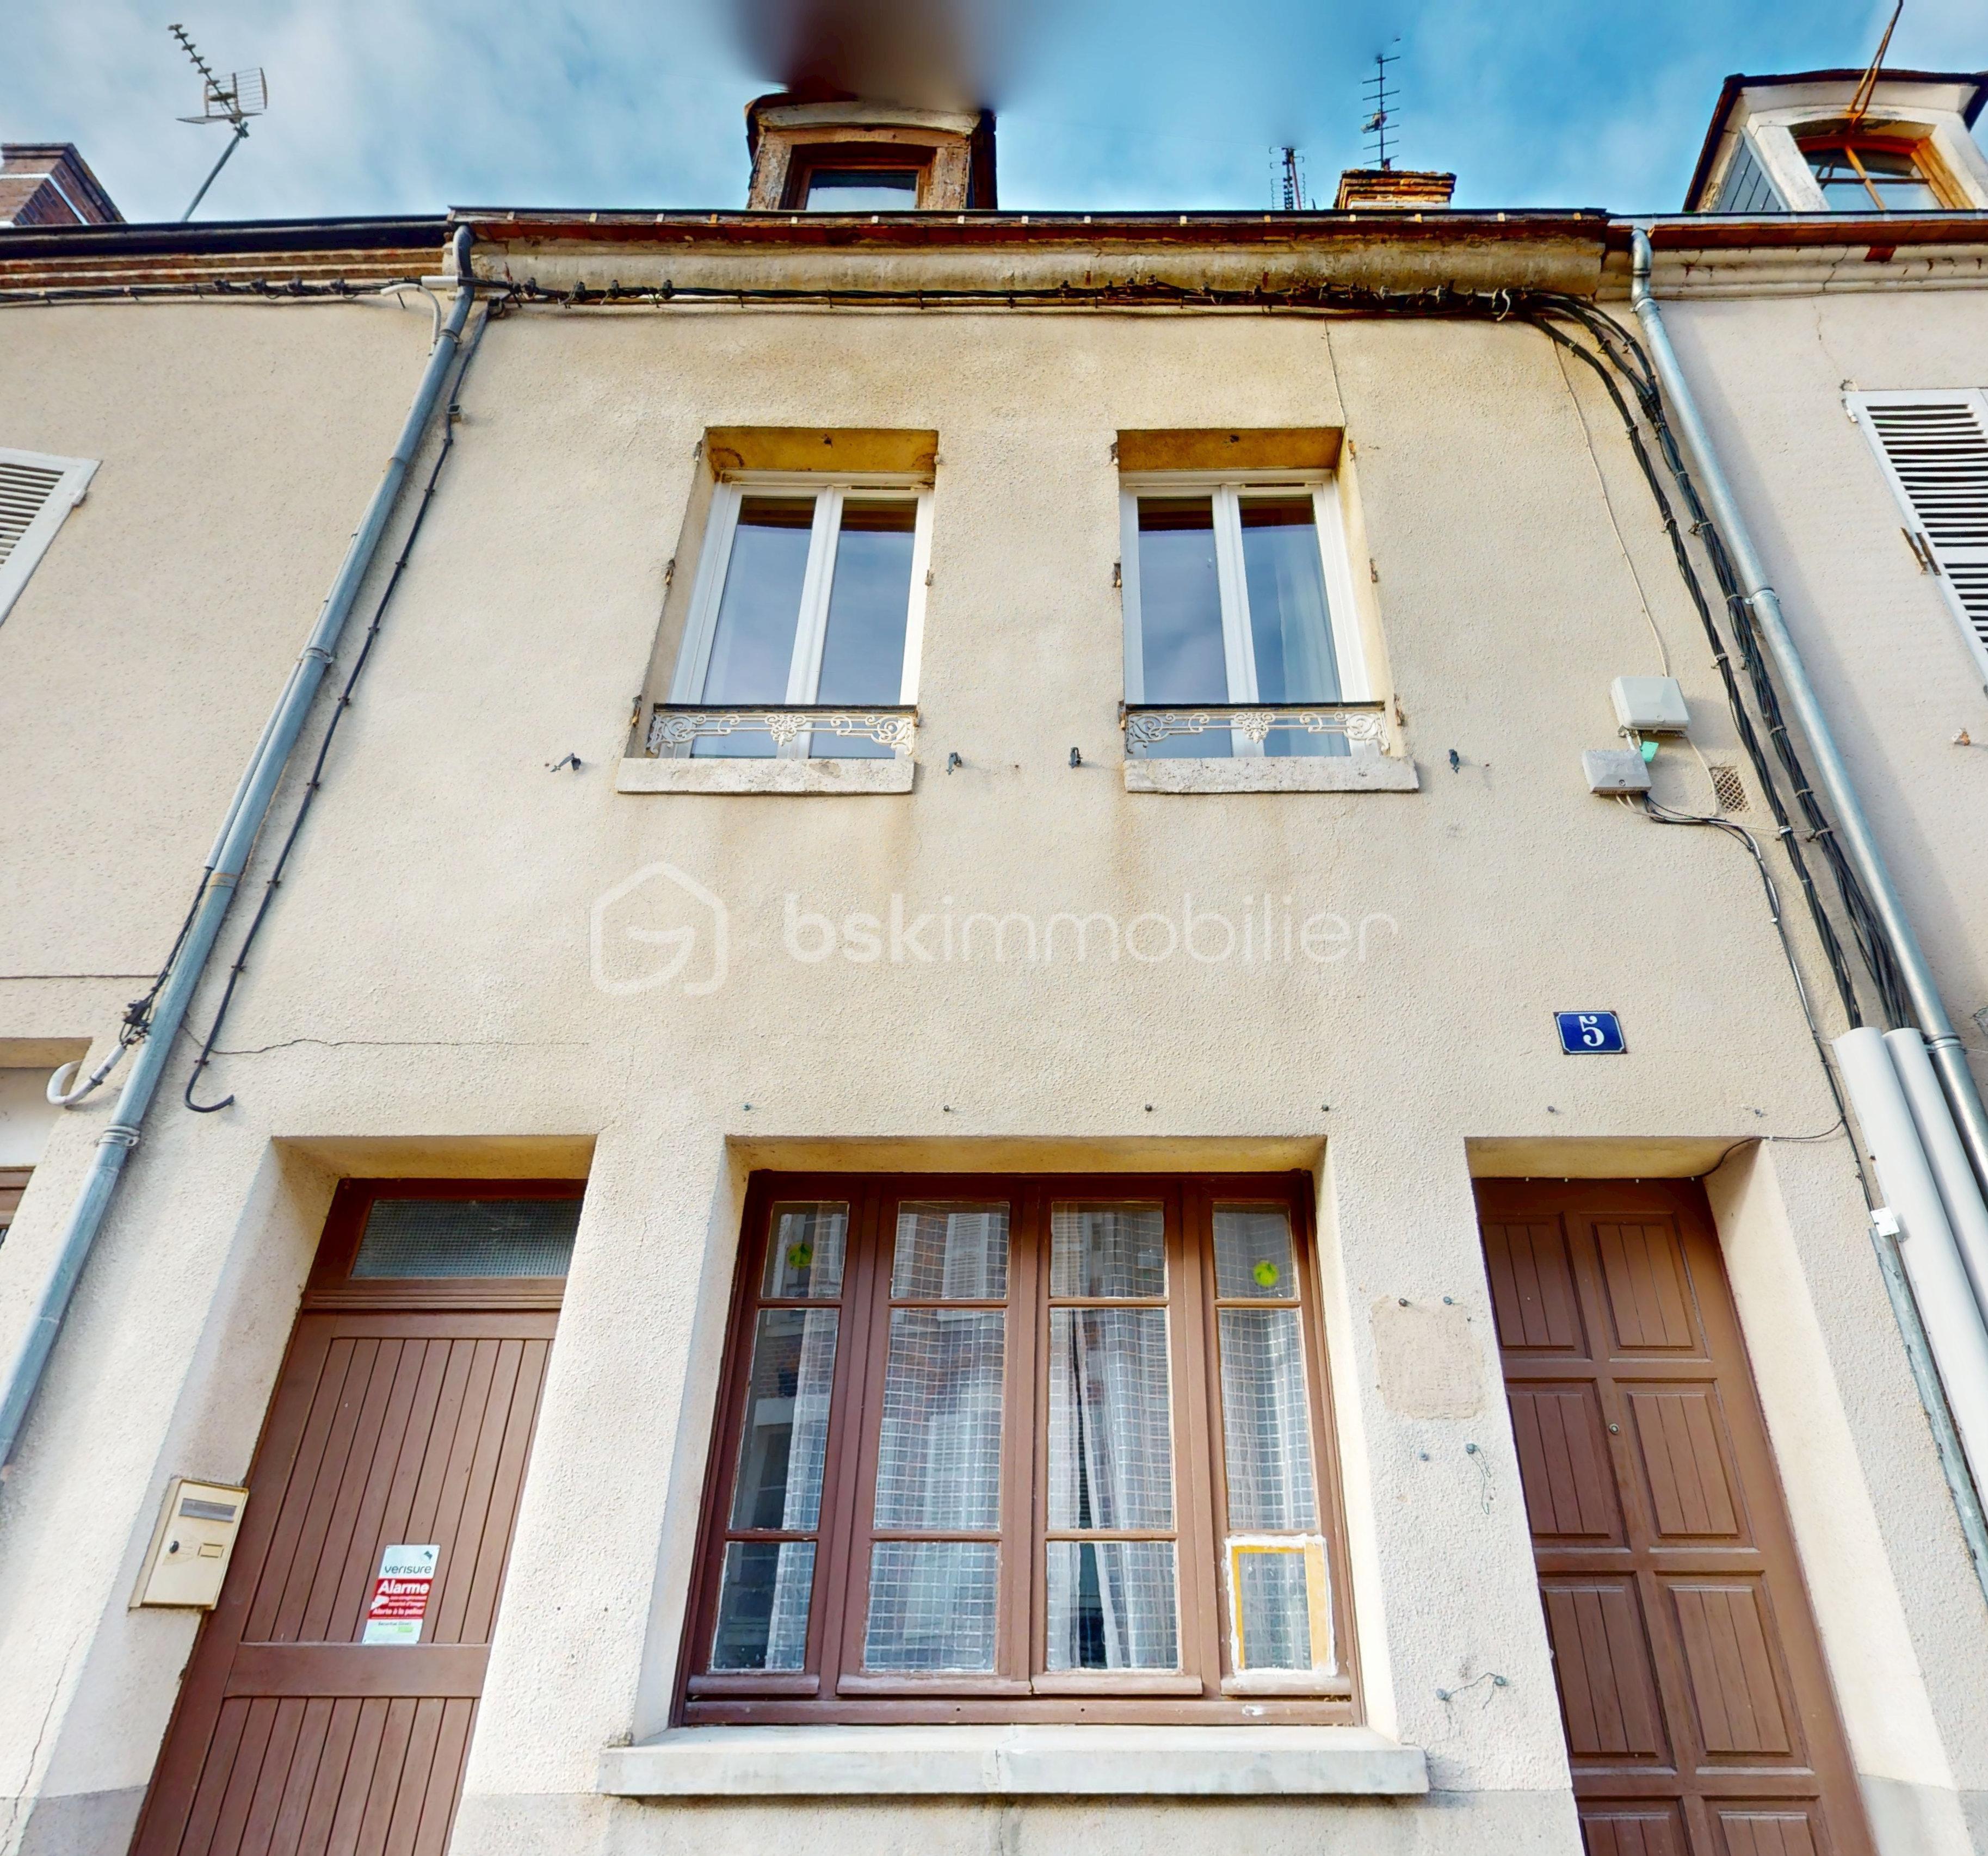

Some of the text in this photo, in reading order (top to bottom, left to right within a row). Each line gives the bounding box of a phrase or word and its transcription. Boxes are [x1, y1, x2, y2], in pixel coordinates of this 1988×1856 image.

[1578, 1016, 1604, 1047] 5
[385, 1566, 431, 1574] verisure
[377, 1579, 430, 1594] Alarme
